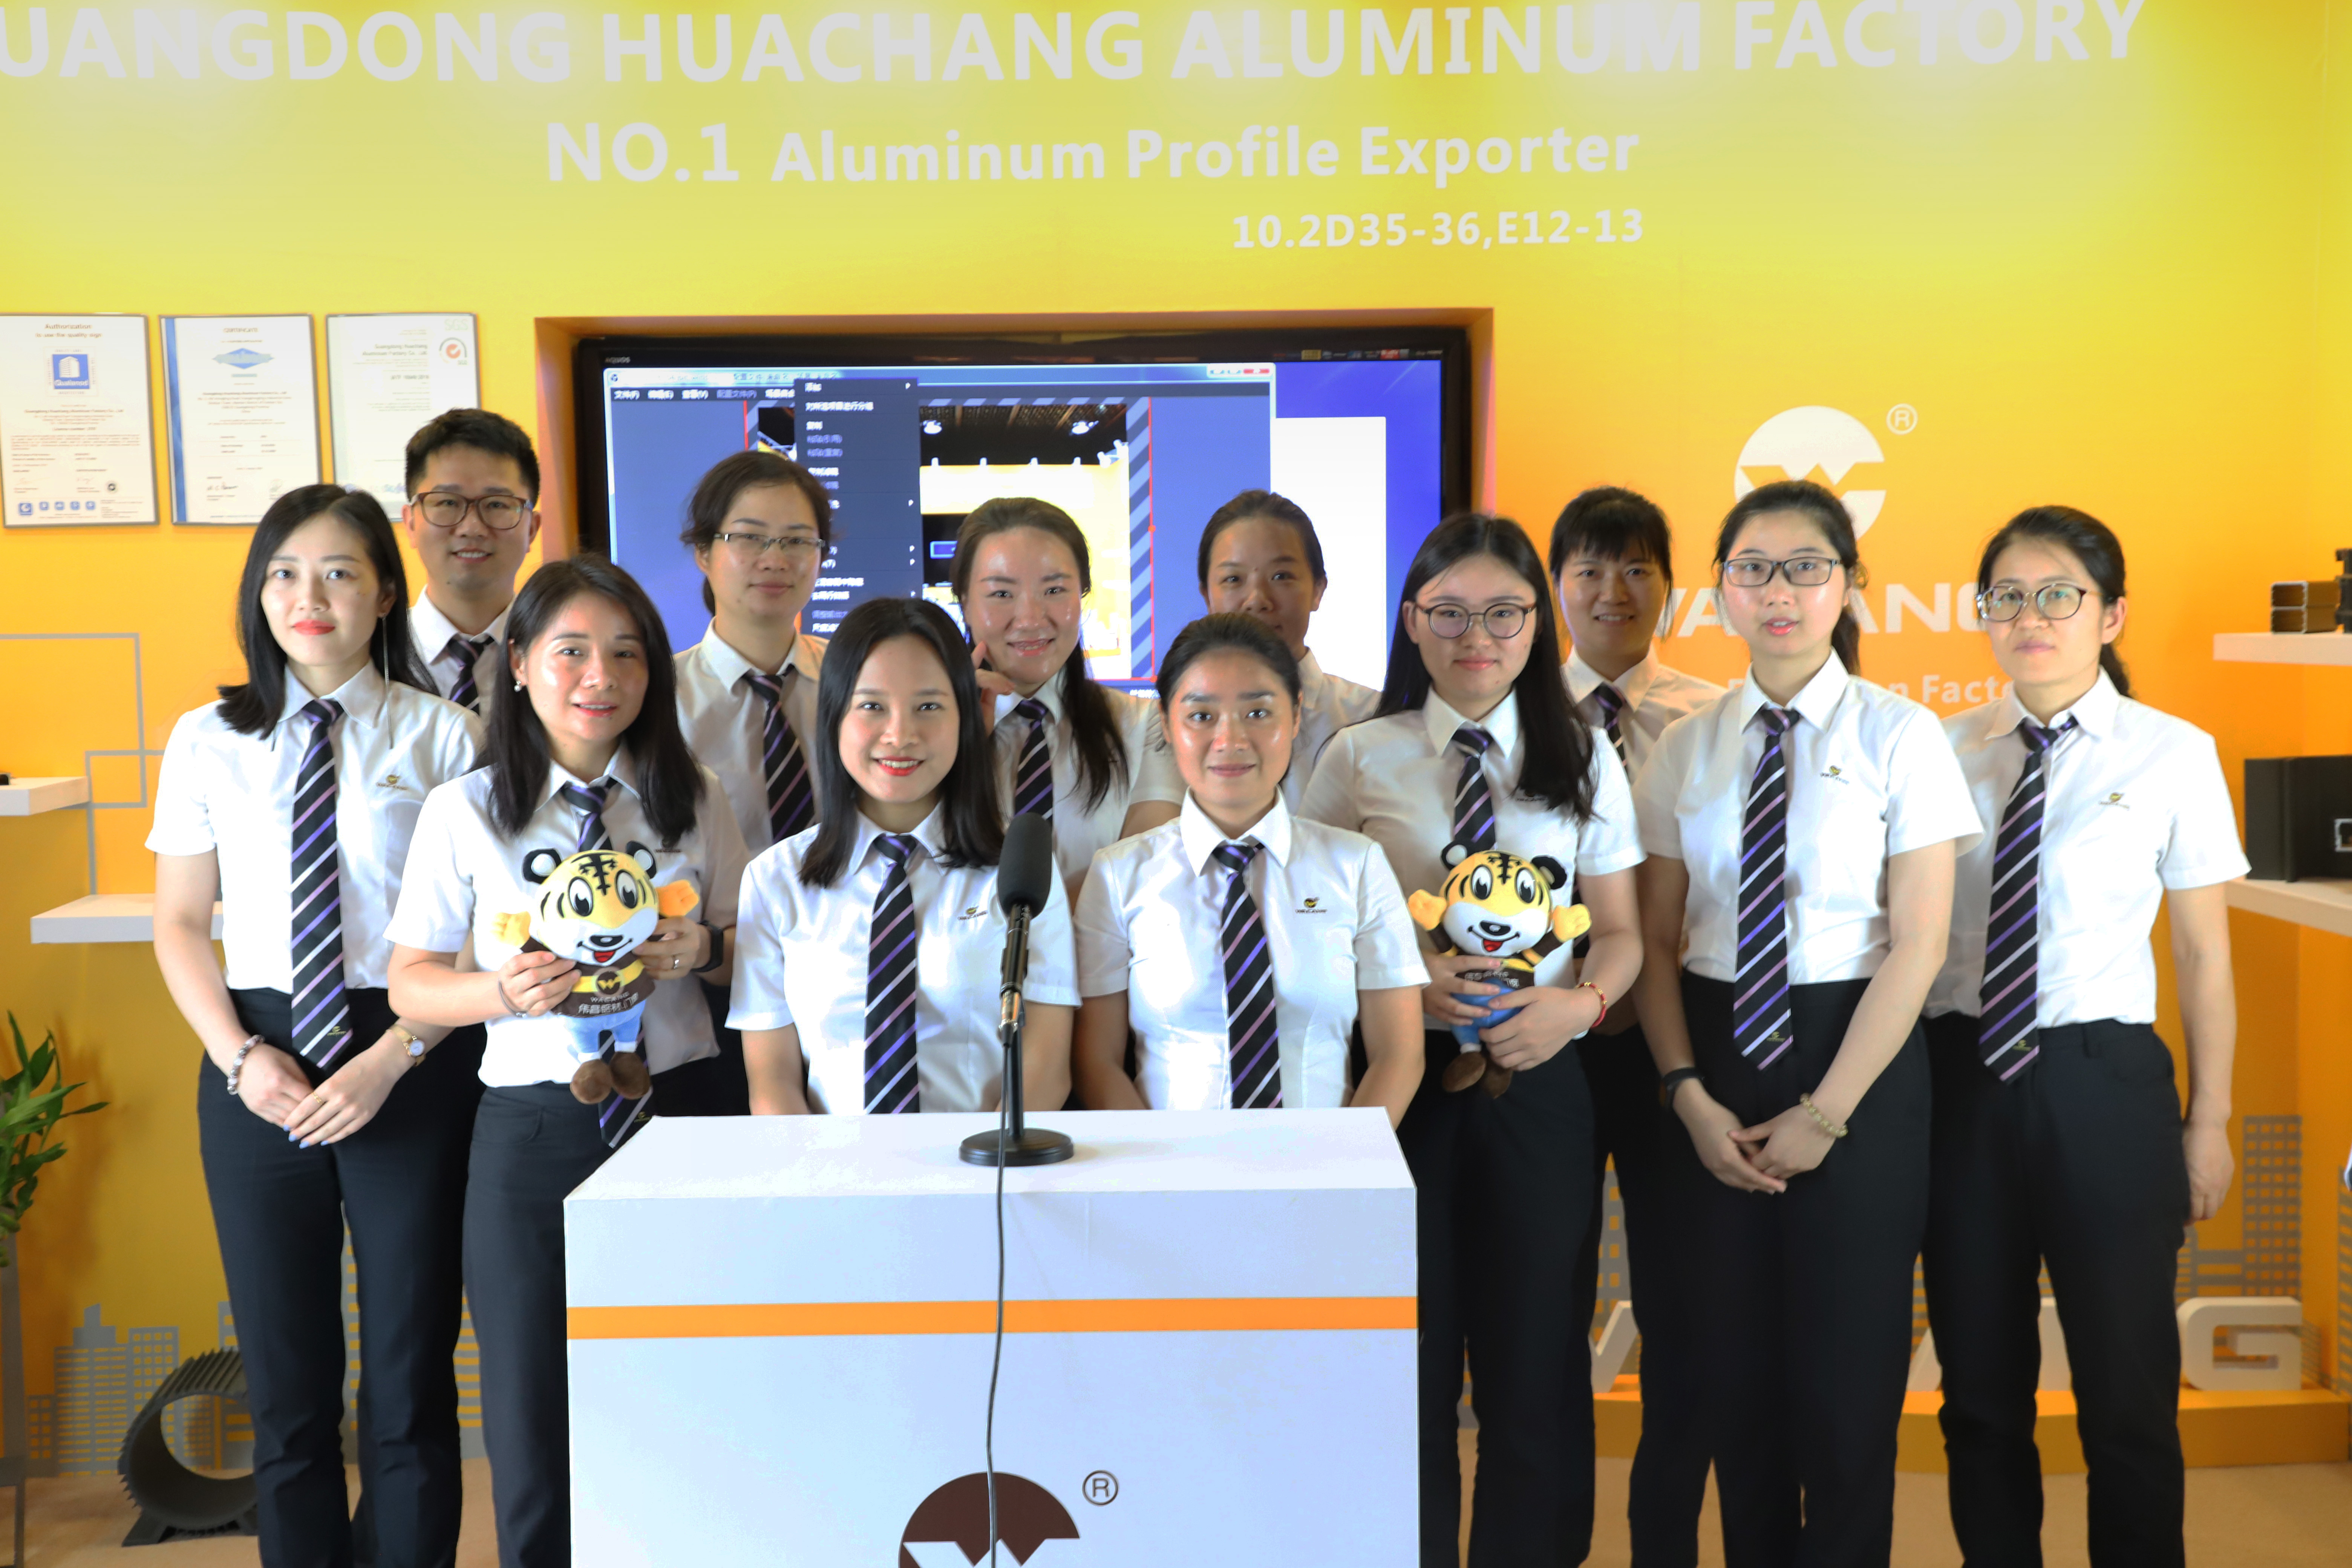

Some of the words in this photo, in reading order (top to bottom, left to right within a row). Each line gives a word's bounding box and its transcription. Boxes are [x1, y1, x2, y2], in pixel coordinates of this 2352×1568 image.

[603, 11, 1143, 83] HUACHANG
[1171, 1, 1701, 78] ALUMINUM
[1734, 0, 2145, 70] FACTORY
[547, 122, 739, 182] NO.1
[771, 129, 1105, 182] Aluminum
[1127, 125, 1339, 179] Profile
[1361, 126, 1639, 188] Exporter
[1232, 208, 1643, 250] 10.2D35-36,E12-13
